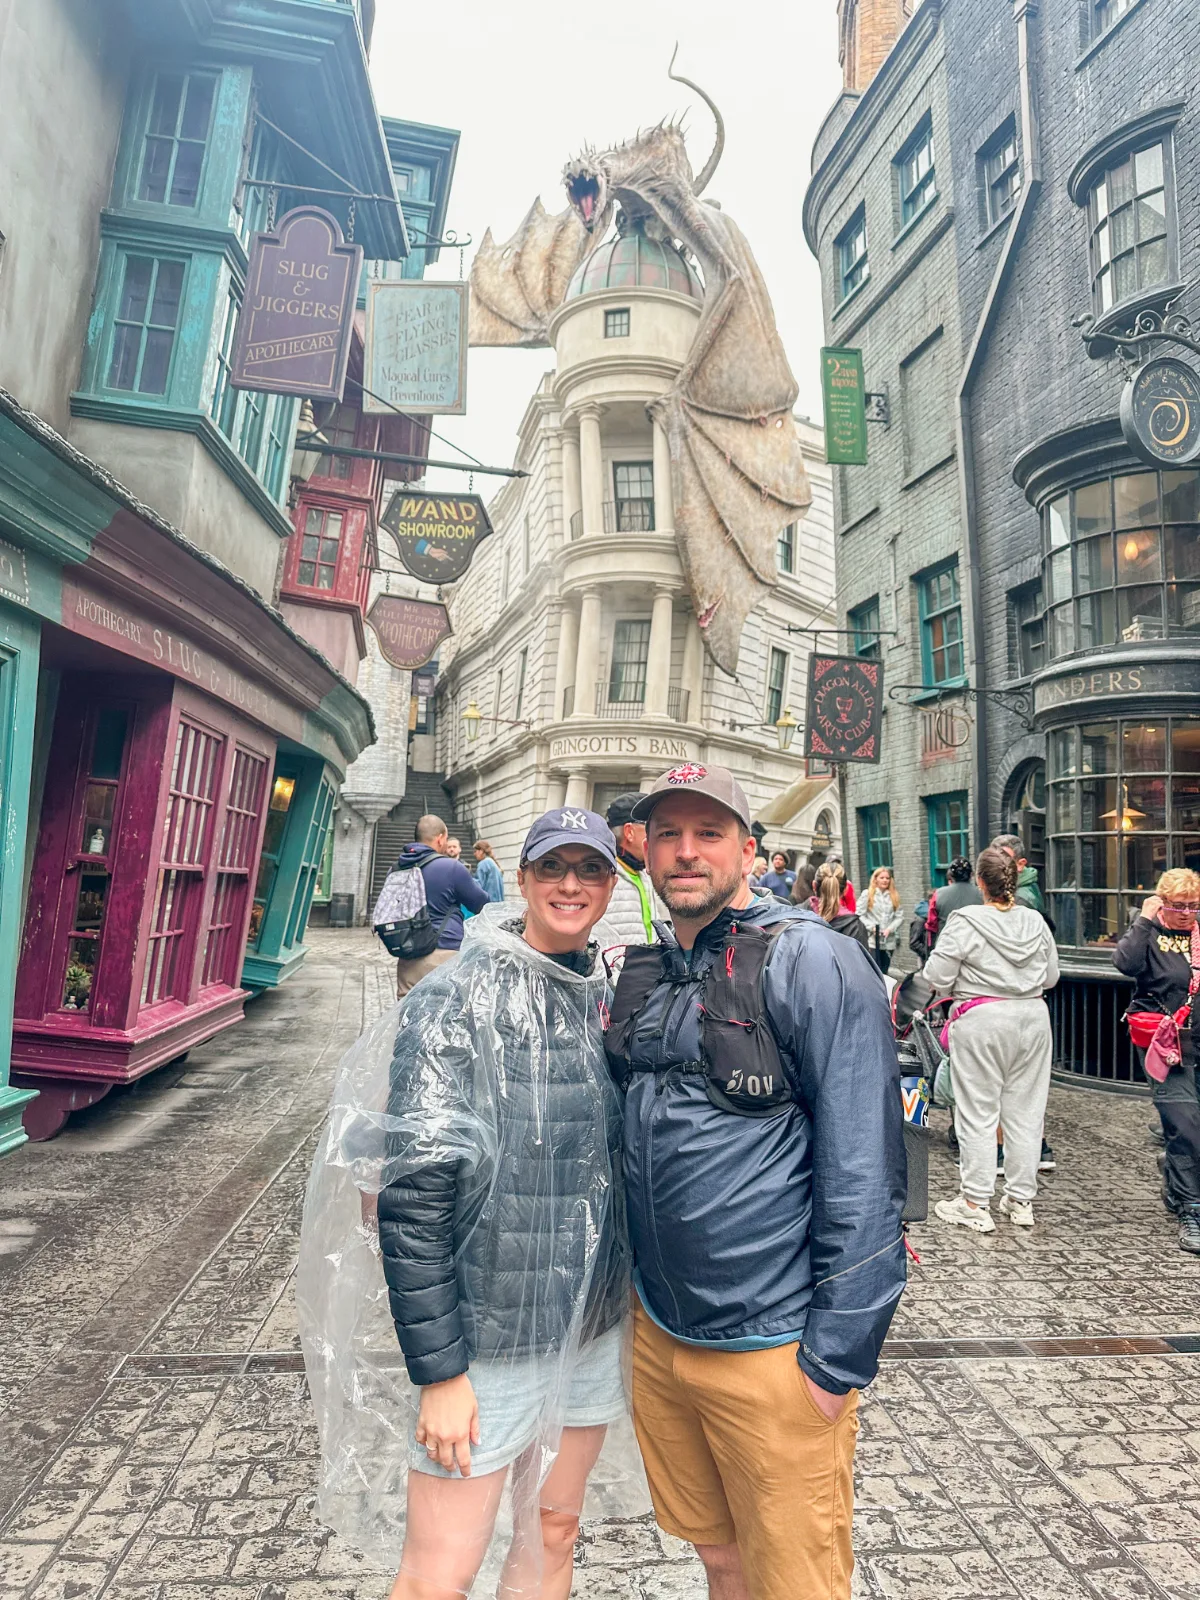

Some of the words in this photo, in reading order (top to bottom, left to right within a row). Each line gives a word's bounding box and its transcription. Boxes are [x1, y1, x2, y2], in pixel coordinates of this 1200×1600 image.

[277, 260, 329, 280] SLUG
[293, 280, 311, 296] &
[253, 295, 340, 320] JIGGERS
[395, 303, 432, 328] FEAR
[395, 315, 445, 345] FLYING
[245, 333, 338, 362] APOTHECARY
[395, 329, 457, 364] GLASSES
[381, 366, 421, 385] Magical
[423, 367, 451, 383] Cures
[389, 385, 445, 402] Preventions
[400, 498, 477, 521] WAND
[399, 521, 475, 539] SHOWROOM
[76, 595, 143, 645] APOTHECARY
[153, 629, 202, 679] SLUG
[379, 620, 441, 650] APOTHECARY
[814, 677, 850, 704] DIAGON
[851, 680, 875, 708] ALLEY
[817, 714, 843, 740] ARTS
[844, 719, 871, 741] CLUB
[552, 737, 637, 757] GRINGOTTS
[650, 739, 688, 758] BANK
[560, 809, 589, 830] NY
